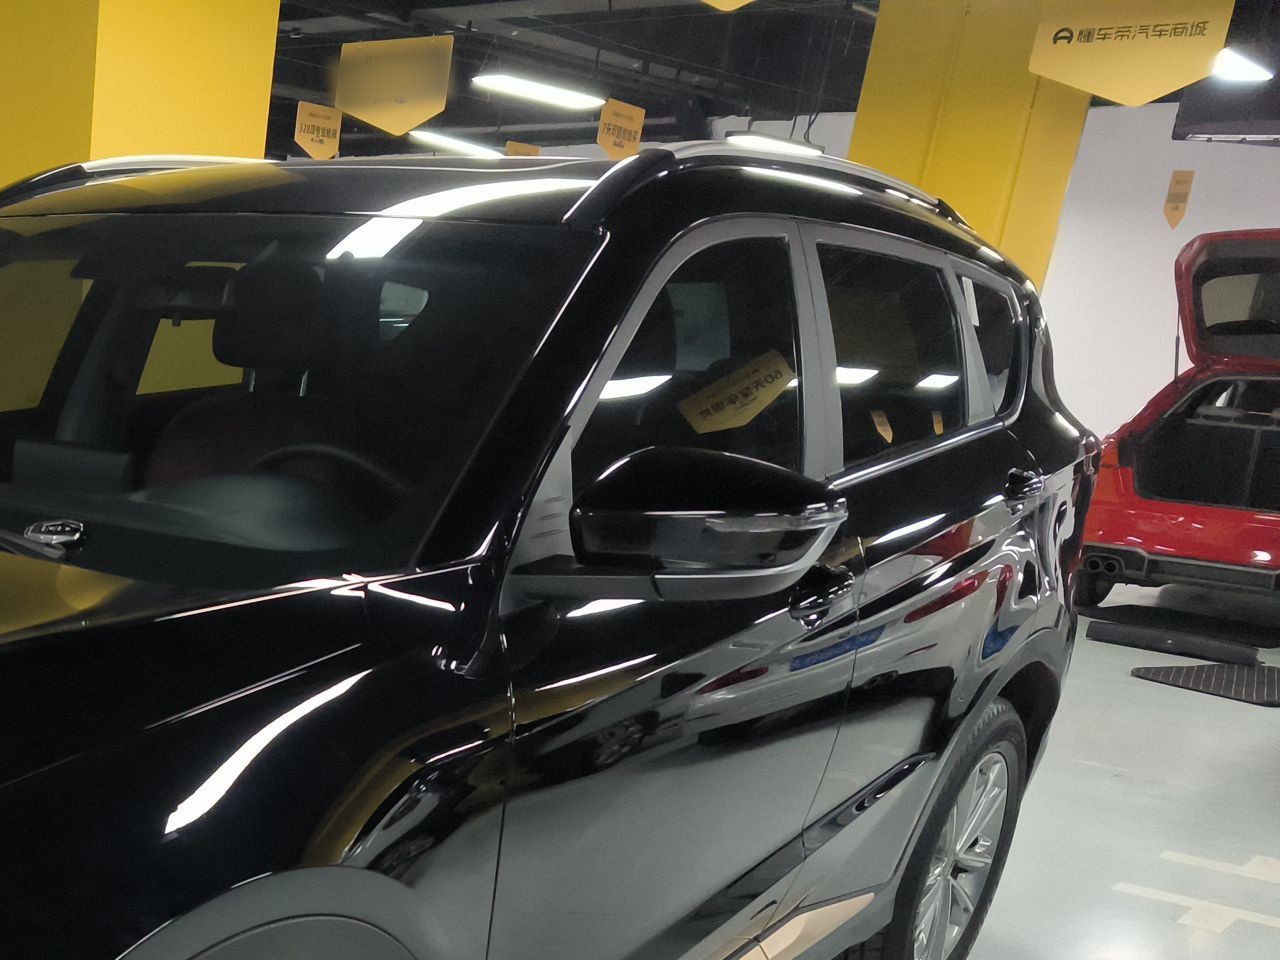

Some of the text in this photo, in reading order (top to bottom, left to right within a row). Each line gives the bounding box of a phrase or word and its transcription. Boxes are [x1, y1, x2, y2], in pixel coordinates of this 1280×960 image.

[1077, 21, 1209, 43] 懂车帝汽车商城
